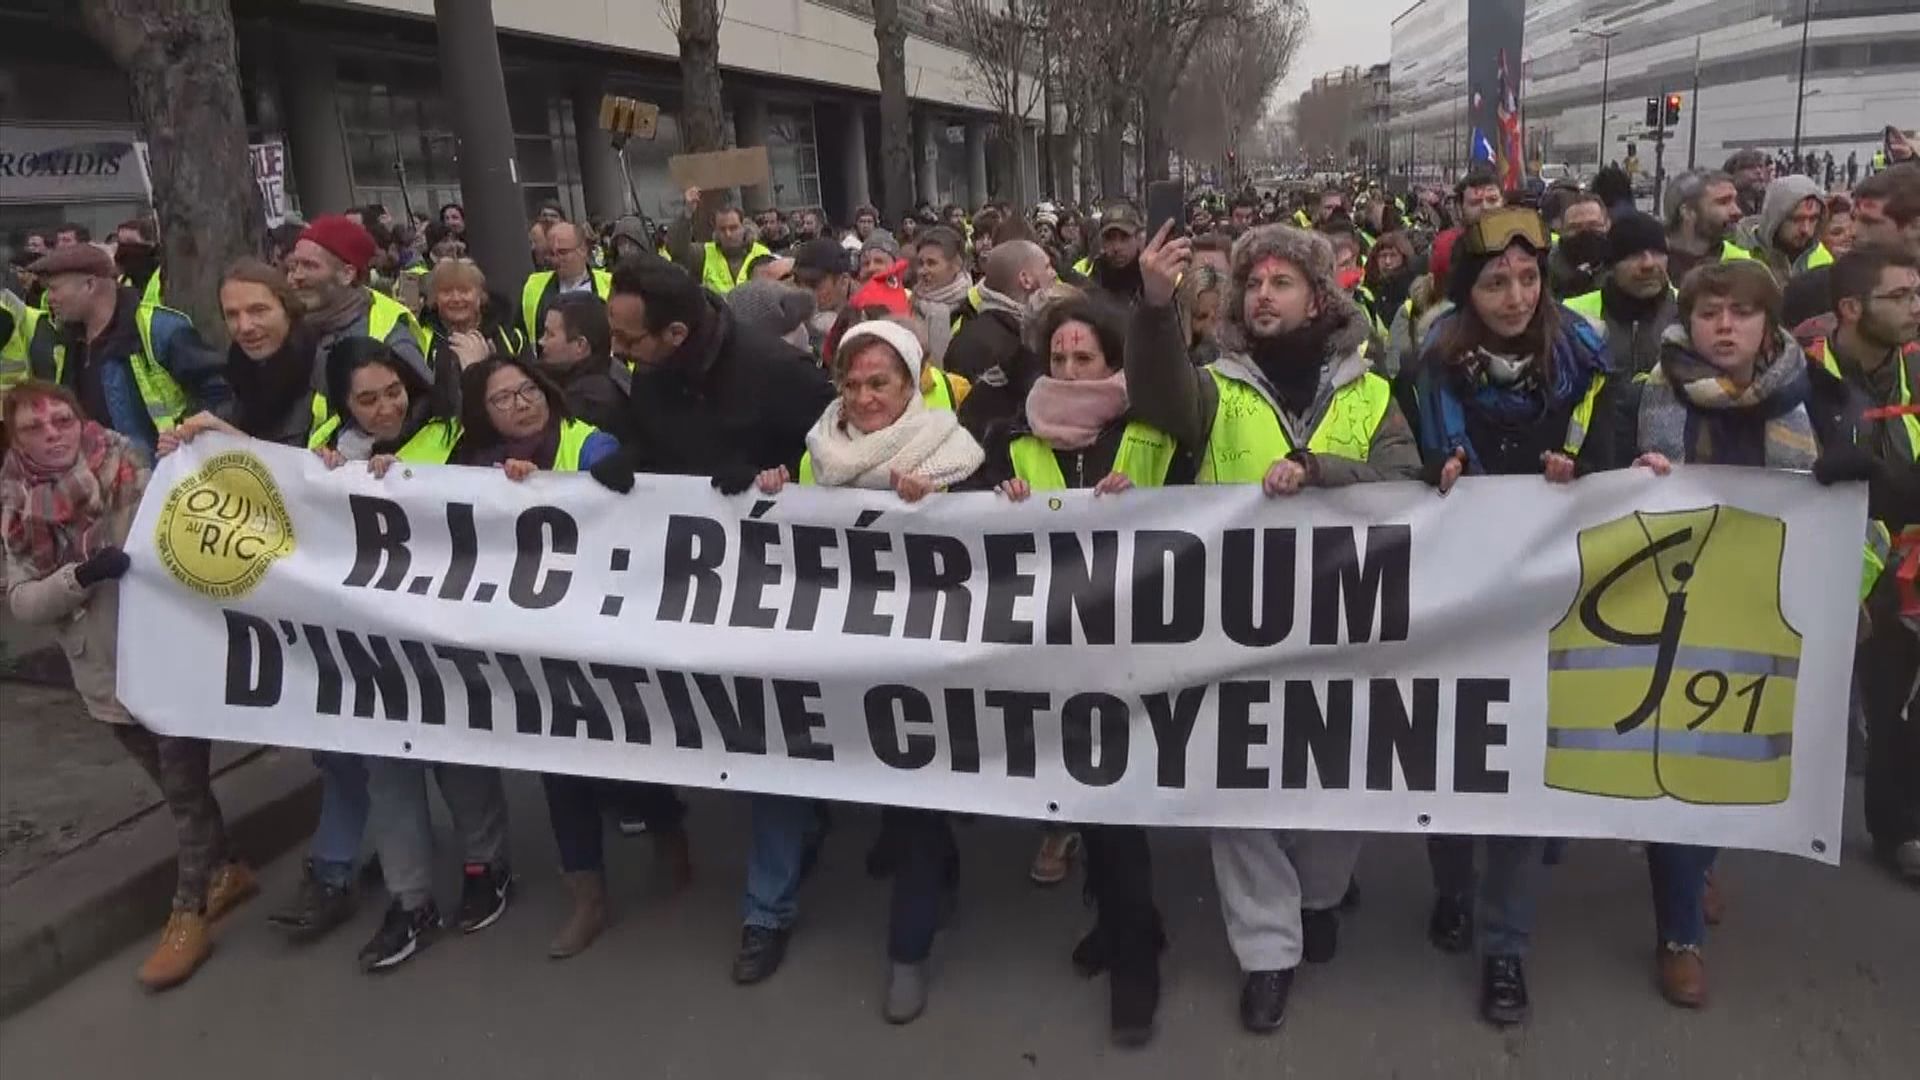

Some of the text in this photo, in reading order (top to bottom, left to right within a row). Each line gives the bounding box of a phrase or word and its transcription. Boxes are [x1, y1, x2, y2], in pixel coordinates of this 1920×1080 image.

[185, 521, 205, 536] AU
[200, 523, 266, 560] RIC
[655, 499, 1412, 648] RÉFÉRENDUM
[223, 607, 1512, 794] D'INITIATIVE CITOYENNE
[1685, 669, 1769, 733] 91
